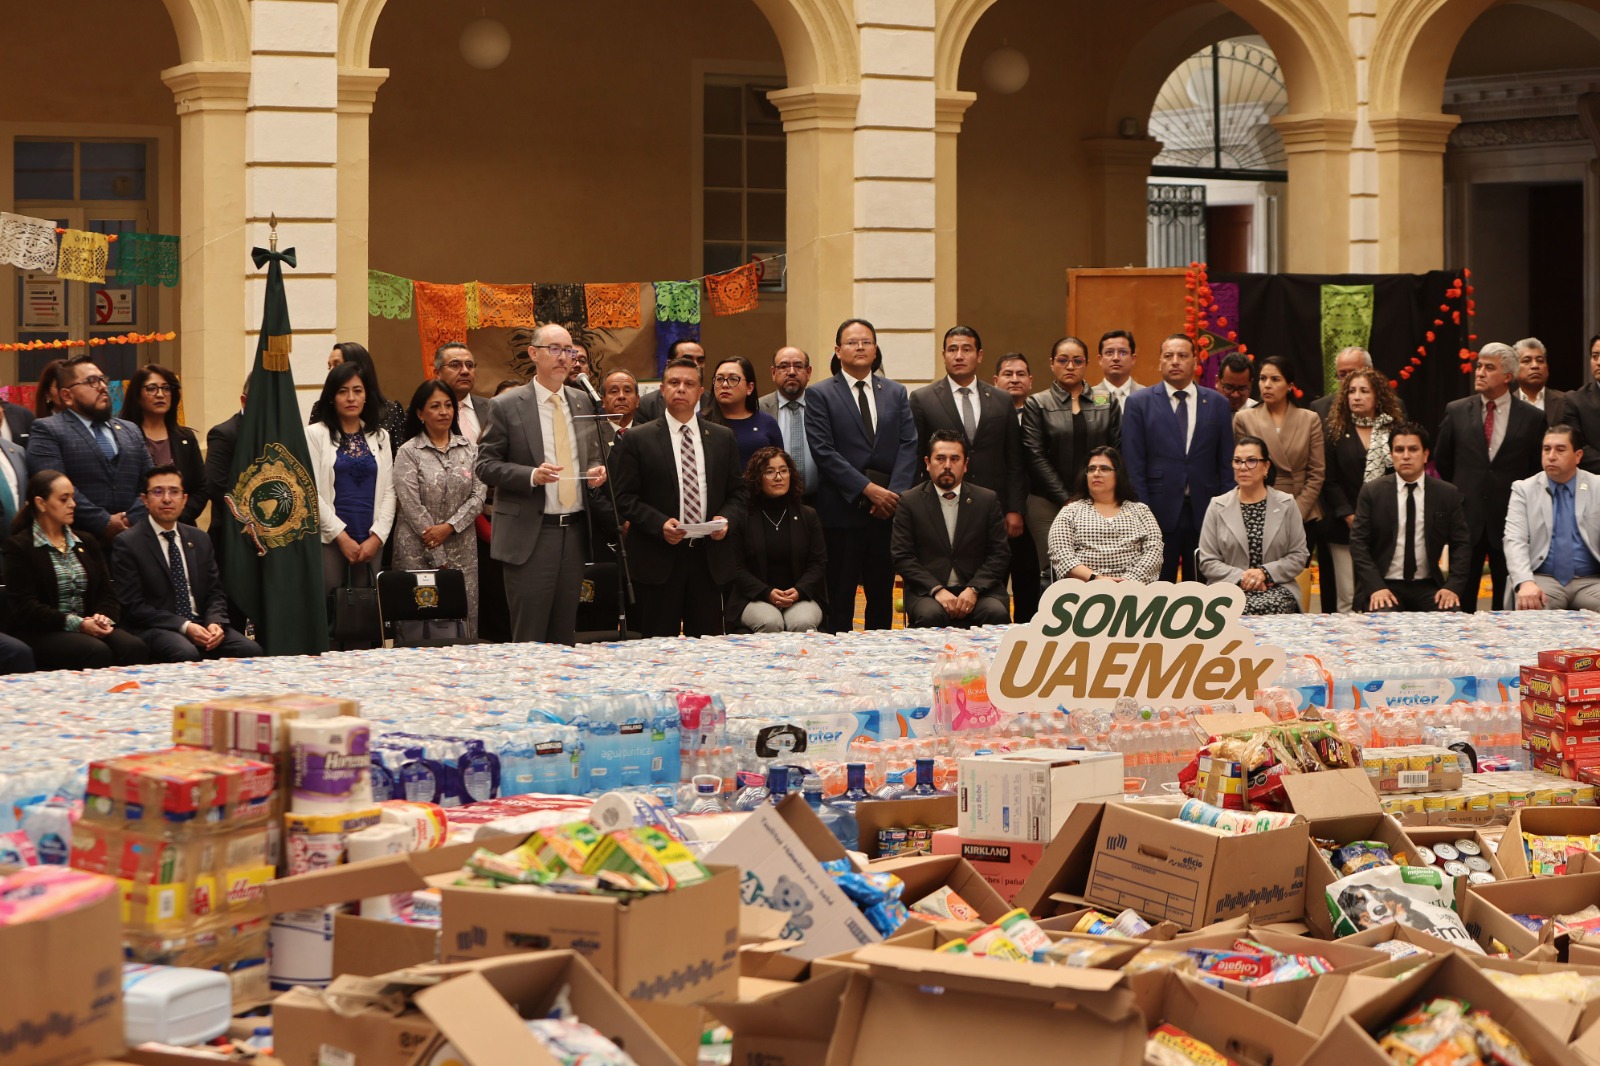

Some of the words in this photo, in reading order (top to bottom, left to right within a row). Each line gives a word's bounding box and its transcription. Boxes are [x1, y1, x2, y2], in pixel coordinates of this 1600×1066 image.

[293, 463, 309, 485] UNIDOS
[305, 485, 318, 523] MEXICANOS
[1041, 592, 1233, 640] SOMOS
[999, 639, 1275, 701] UAEMéx
[1385, 694, 1440, 707] water
[1533, 700, 1554, 718] Canelitas
[808, 730, 843, 744] ater
[601, 750, 621, 760] agua
[963, 845, 1009, 857] KIRKLAND
[1182, 857, 1203, 868] oficio
[1132, 863, 1157, 876] CONTENIDO
[1004, 878, 1024, 886] pañal
[1218, 960, 1259, 974] Colgate
